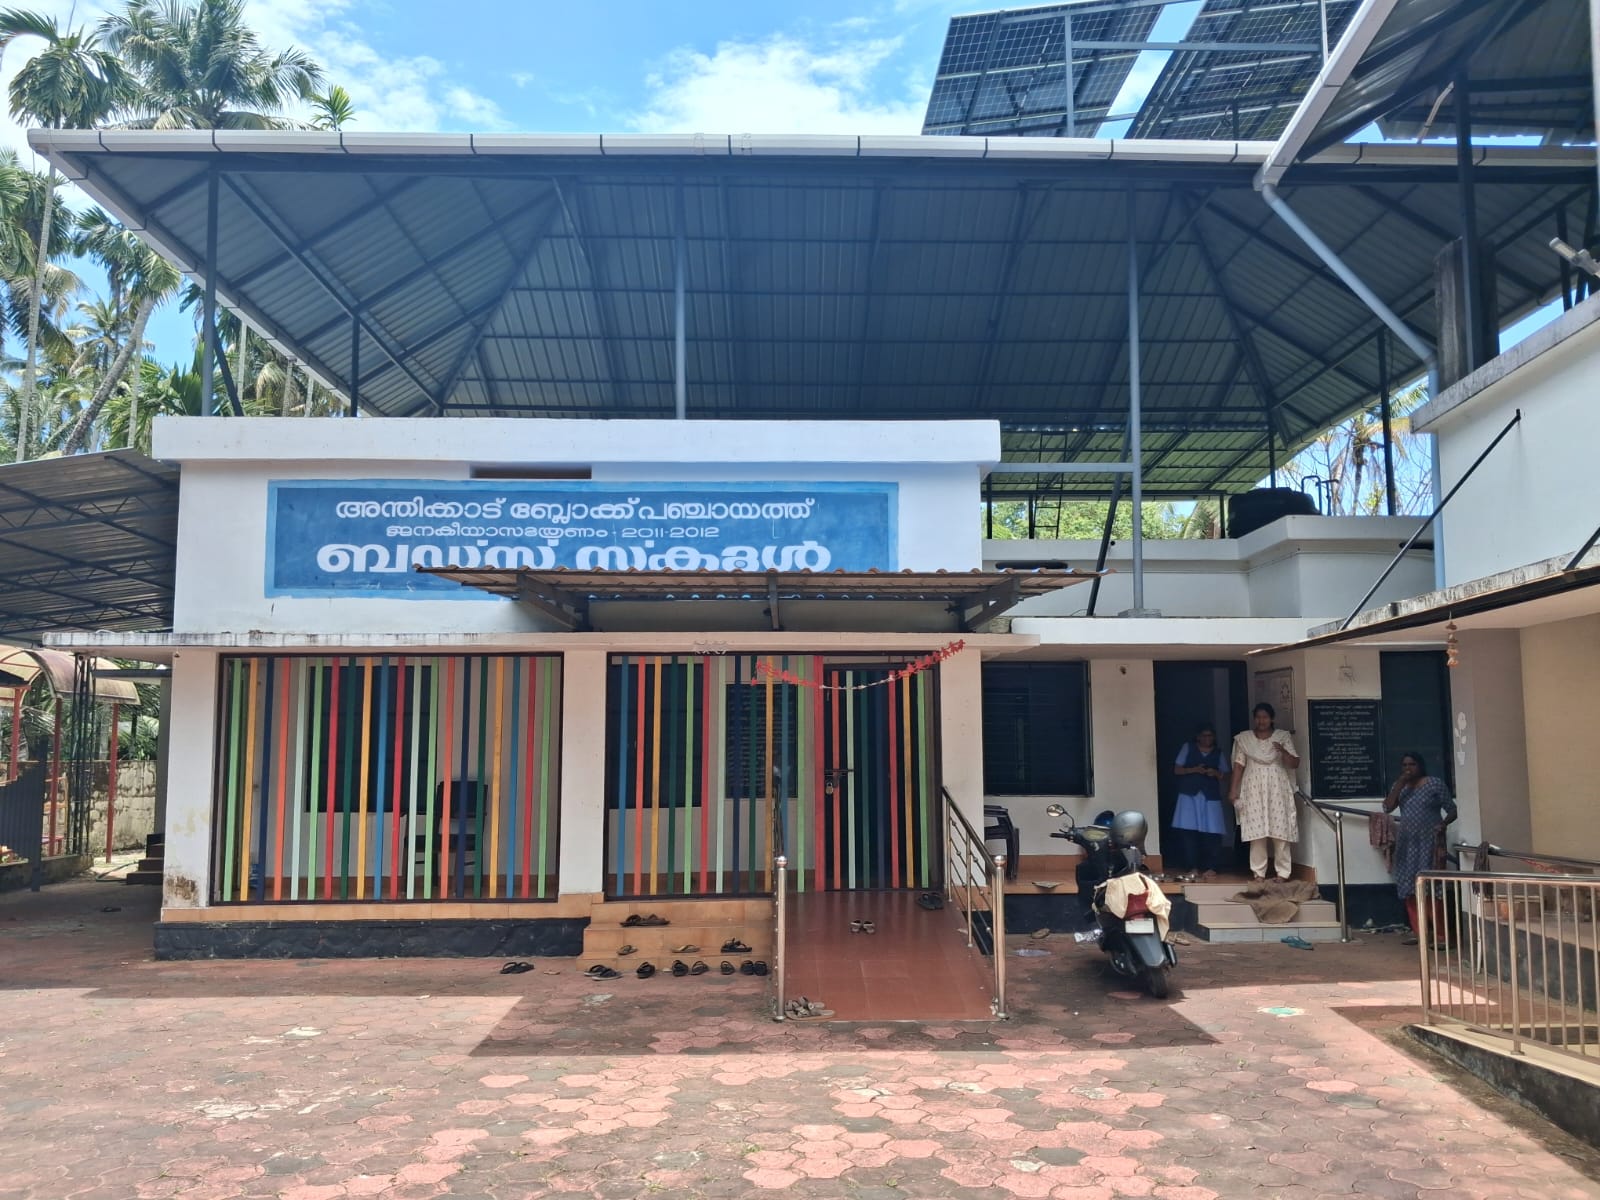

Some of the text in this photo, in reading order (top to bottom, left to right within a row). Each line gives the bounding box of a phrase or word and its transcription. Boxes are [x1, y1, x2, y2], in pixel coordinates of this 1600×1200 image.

[336, 496, 816, 524] അന്തിക്കാട് ബ്ലോക്ക് പഞ്ചായത്ത്
[621, 526, 720, 538] 2011-2012
